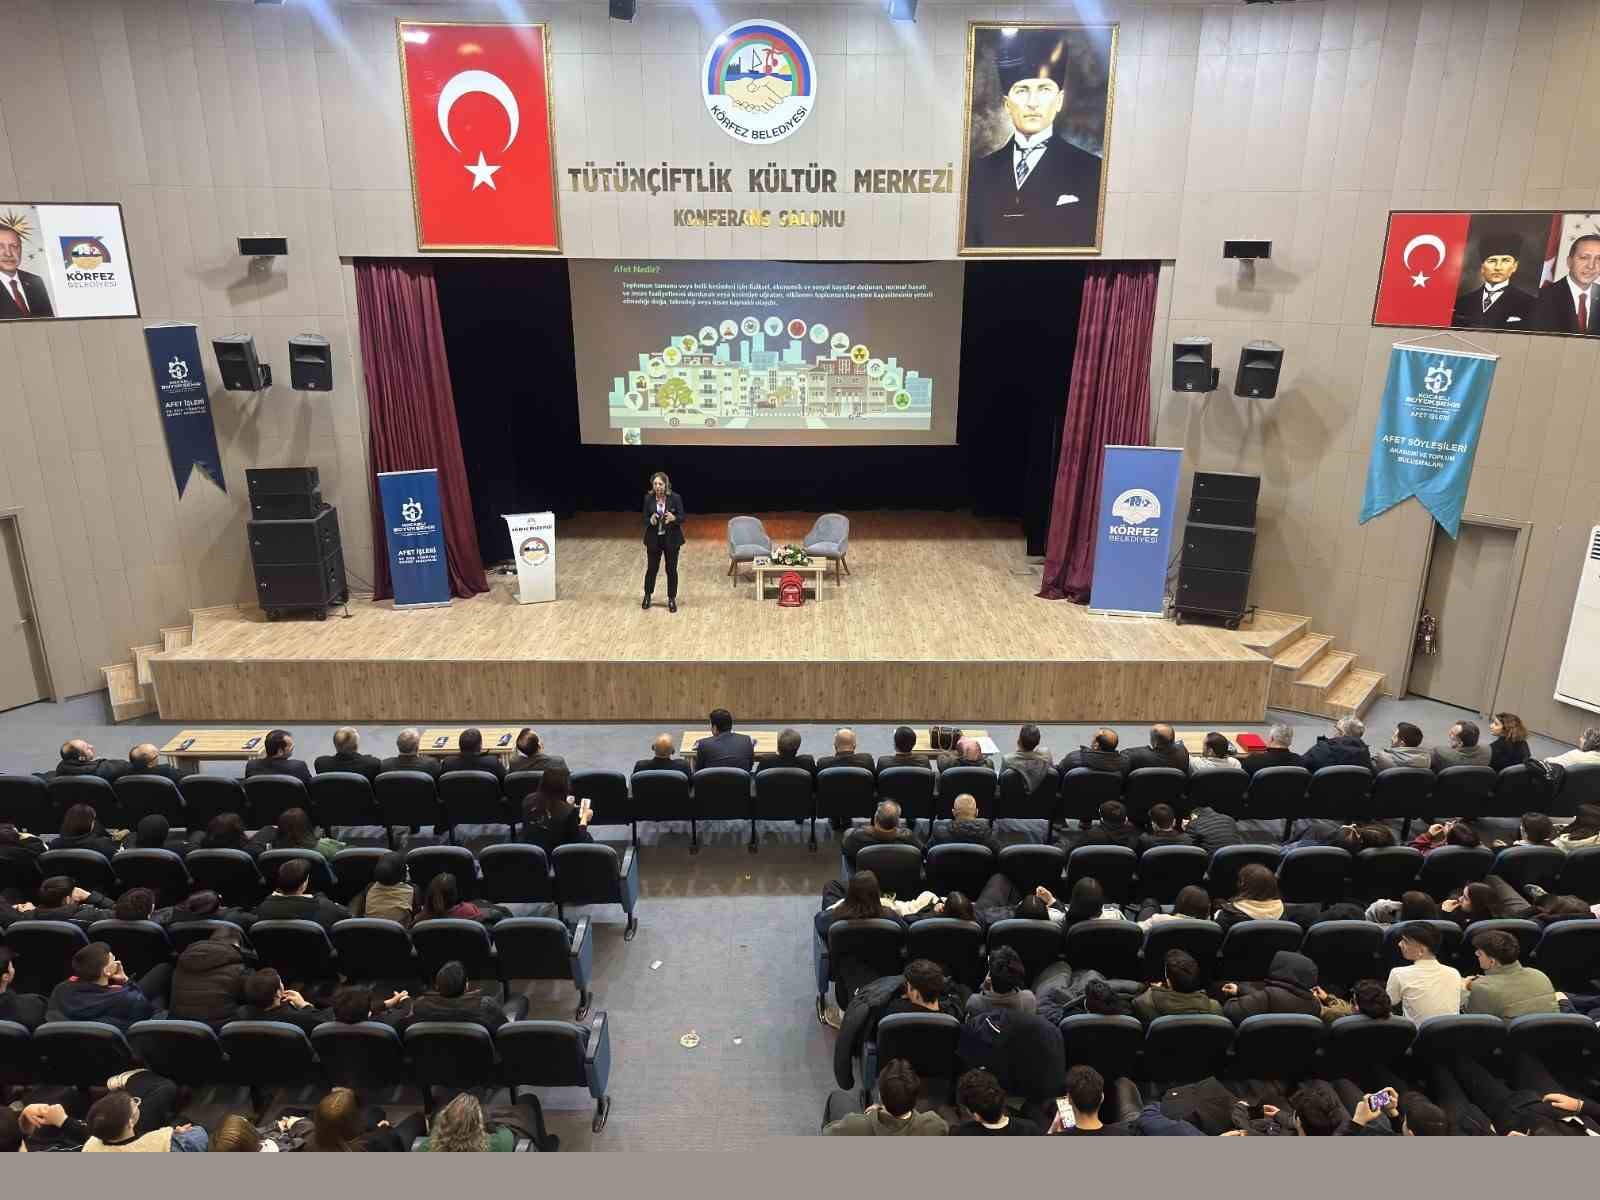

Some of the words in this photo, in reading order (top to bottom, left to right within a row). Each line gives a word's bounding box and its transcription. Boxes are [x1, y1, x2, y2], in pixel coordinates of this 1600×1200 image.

[711, 104, 749, 138] KÖRFEZ
[751, 105, 808, 139] BELEDİYESİ
[567, 161, 733, 197] TÜTÜNÇİFTLİK
[749, 162, 838, 194] KÜLTÜR
[854, 162, 954, 194] MERKEZİ
[673, 208, 771, 228] KONFERANS
[779, 208, 846, 228] SALONU
[66, 270, 116, 281] KÖRFEZ
[1382, 434, 1406, 444] AFET
[1407, 437, 1468, 453] SÖYLEŞİLERİ
[1109, 524, 1160, 537] KÖRFEZ
